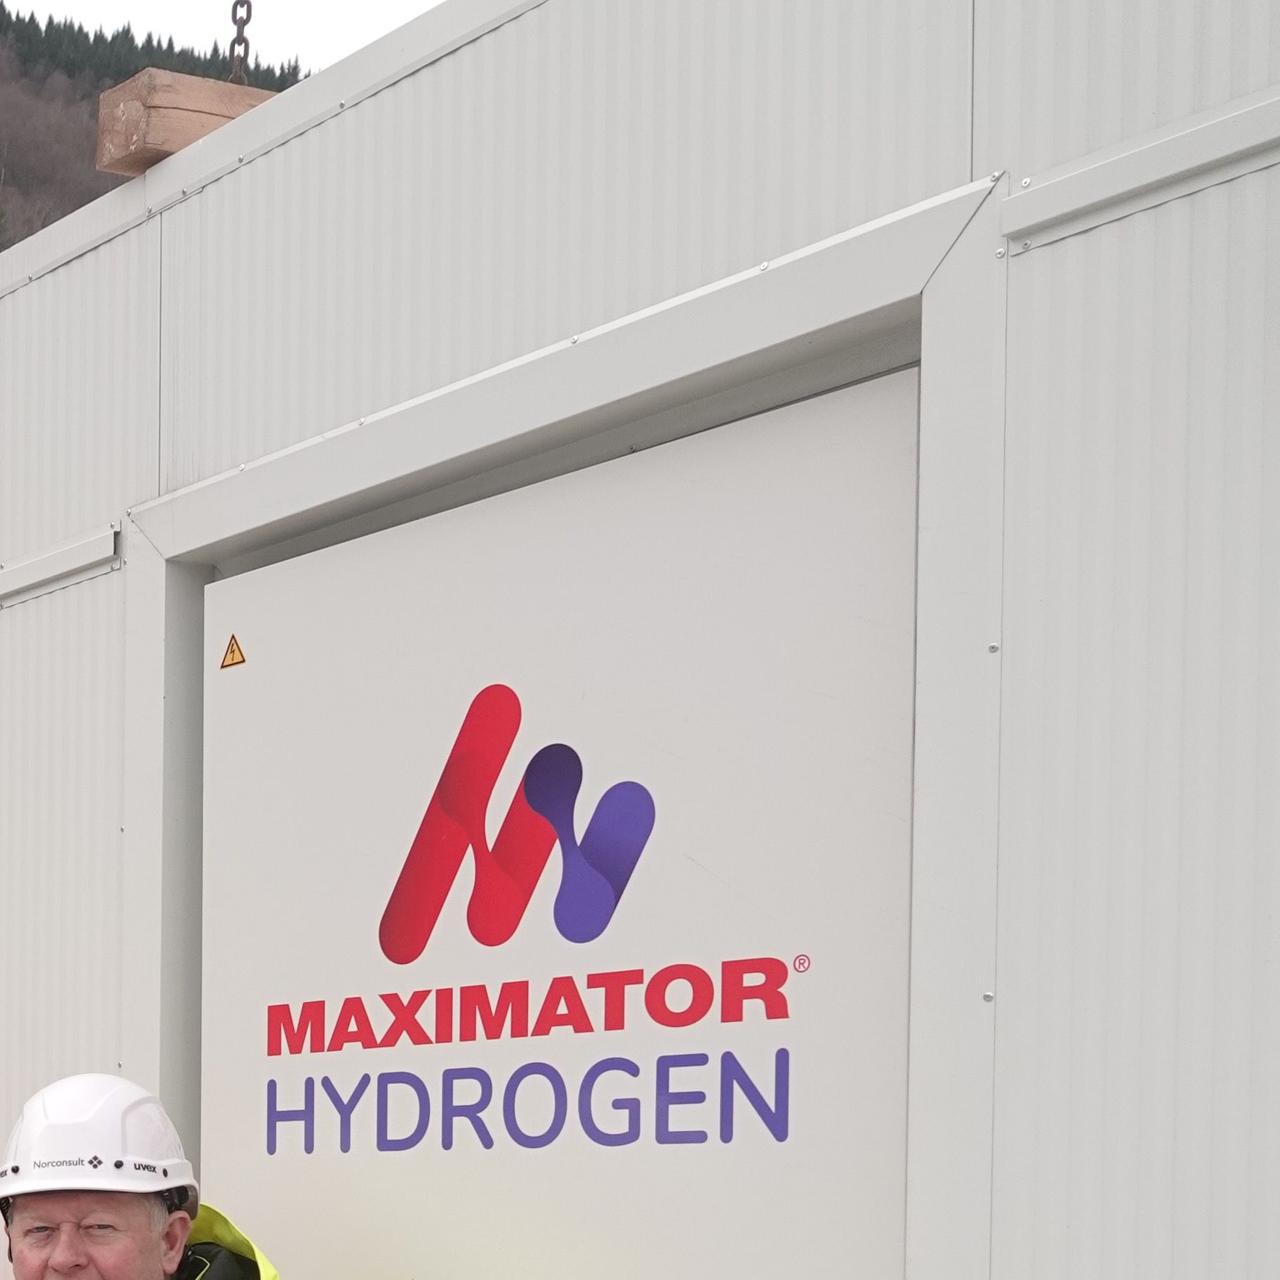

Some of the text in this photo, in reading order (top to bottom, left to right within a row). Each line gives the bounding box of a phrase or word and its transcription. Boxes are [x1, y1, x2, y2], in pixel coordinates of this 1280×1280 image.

[267, 1048, 790, 1155] HYDROGEN
[33, 1158, 85, 1169] Norconsult
[134, 1162, 157, 1173] uvex
